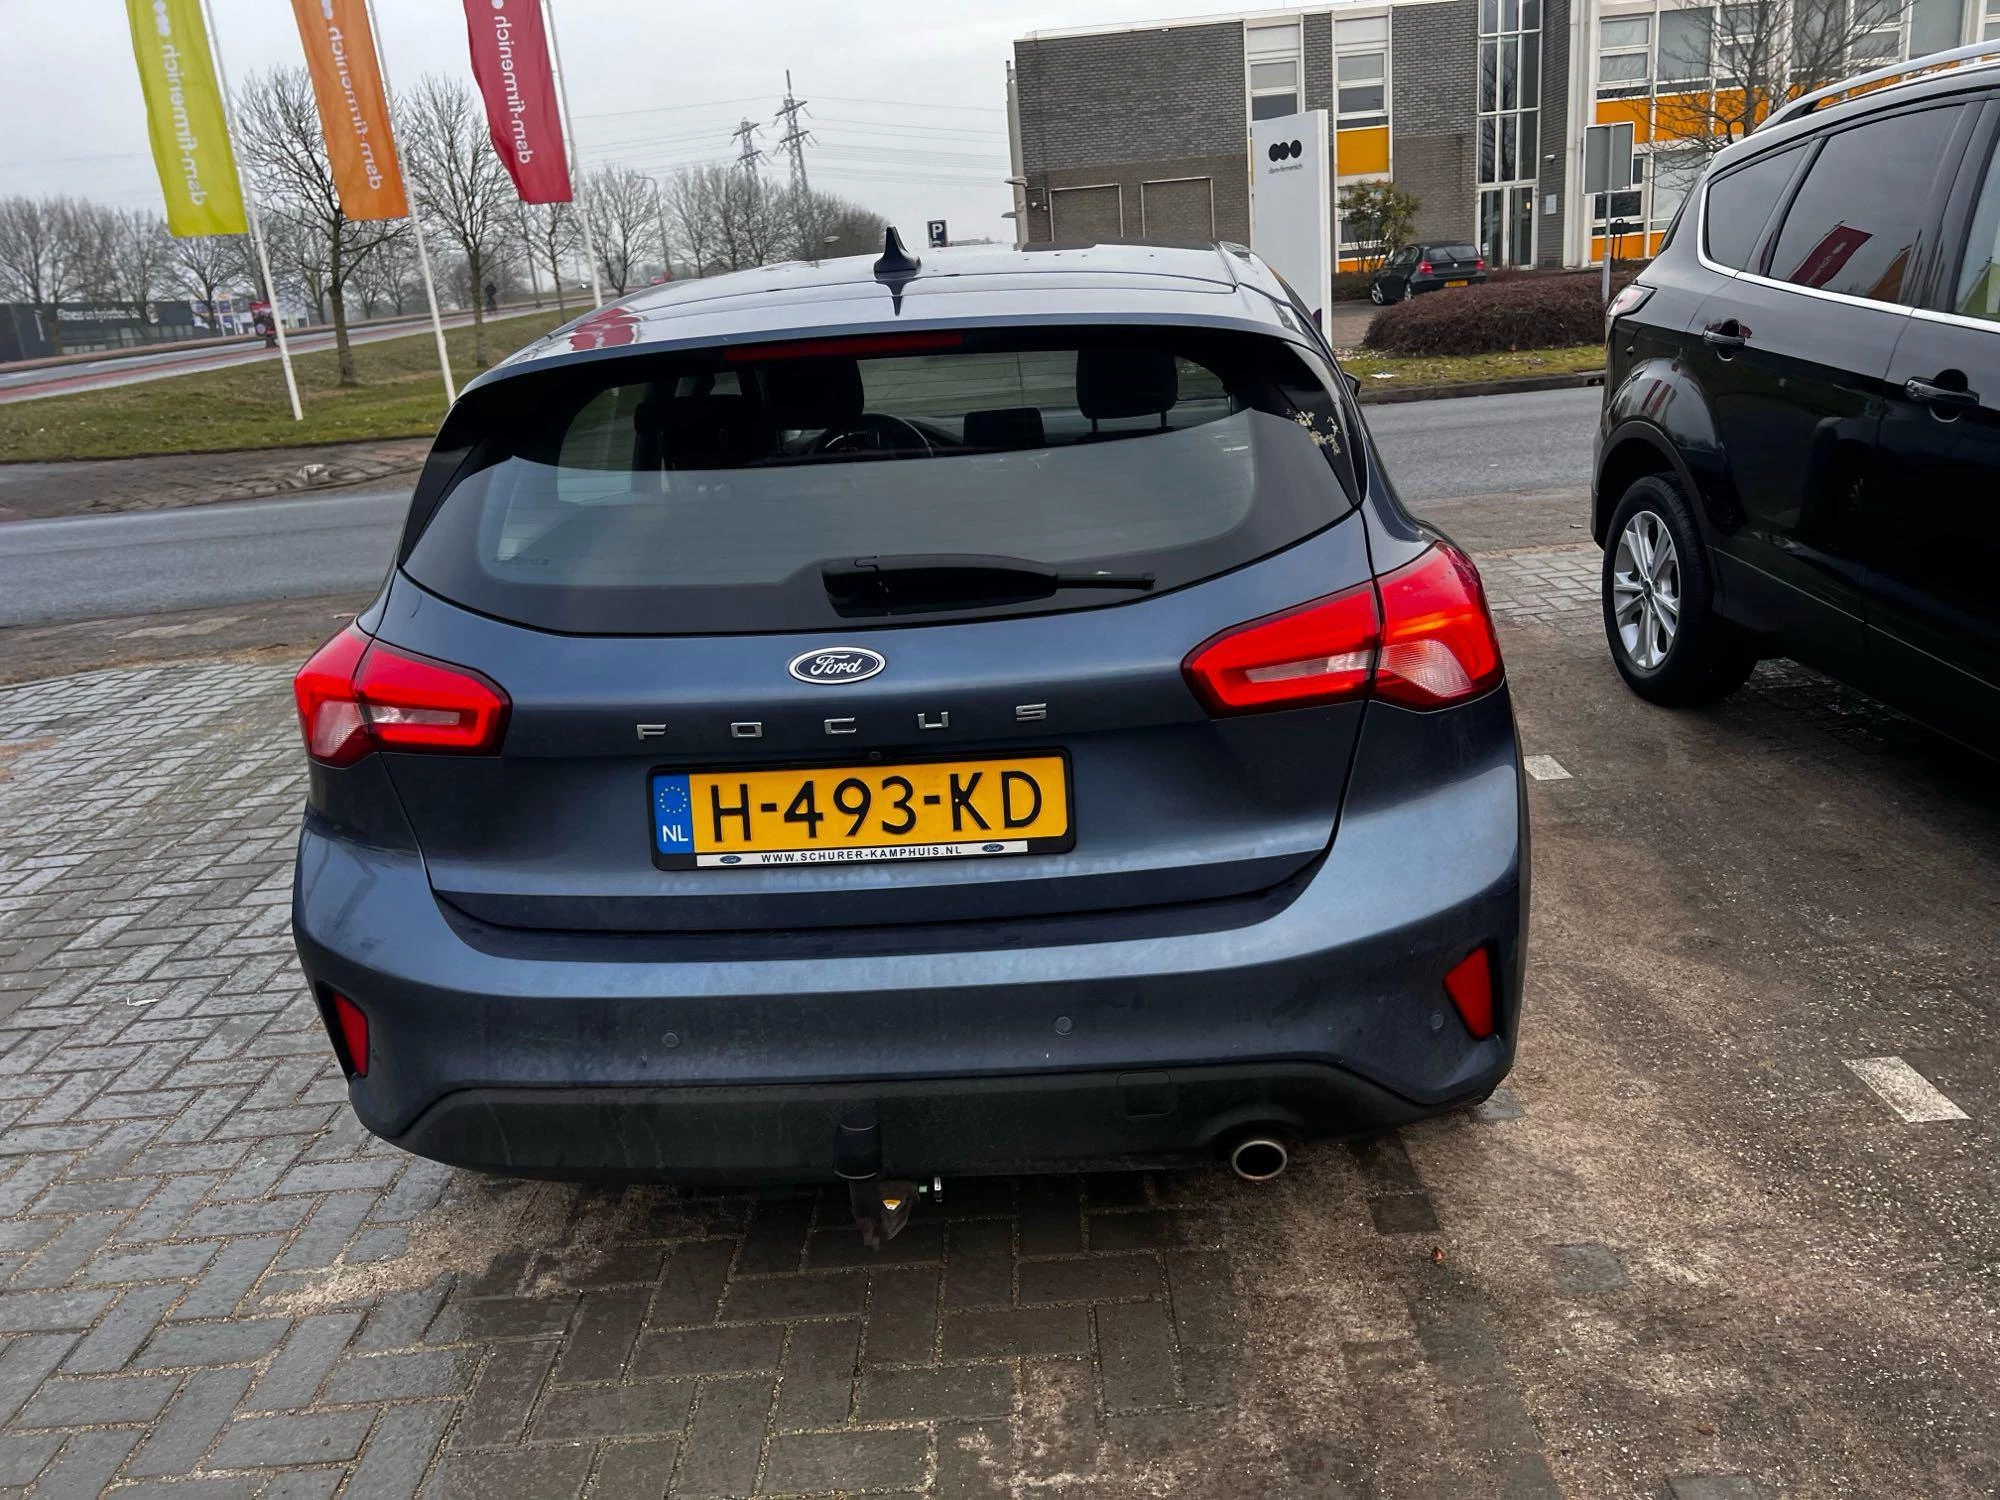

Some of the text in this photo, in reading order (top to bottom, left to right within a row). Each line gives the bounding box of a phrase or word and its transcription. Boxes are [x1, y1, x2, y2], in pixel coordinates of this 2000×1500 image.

[931, 223, 944, 239] P
[810, 654, 863, 676] Ford
[636, 702, 1048, 741] FOCUS
[710, 770, 1043, 843] H-493-KD
[662, 825, 689, 843] NL
[760, 845, 963, 863] WWW.SCHURER-KAMPHUIS.NL
